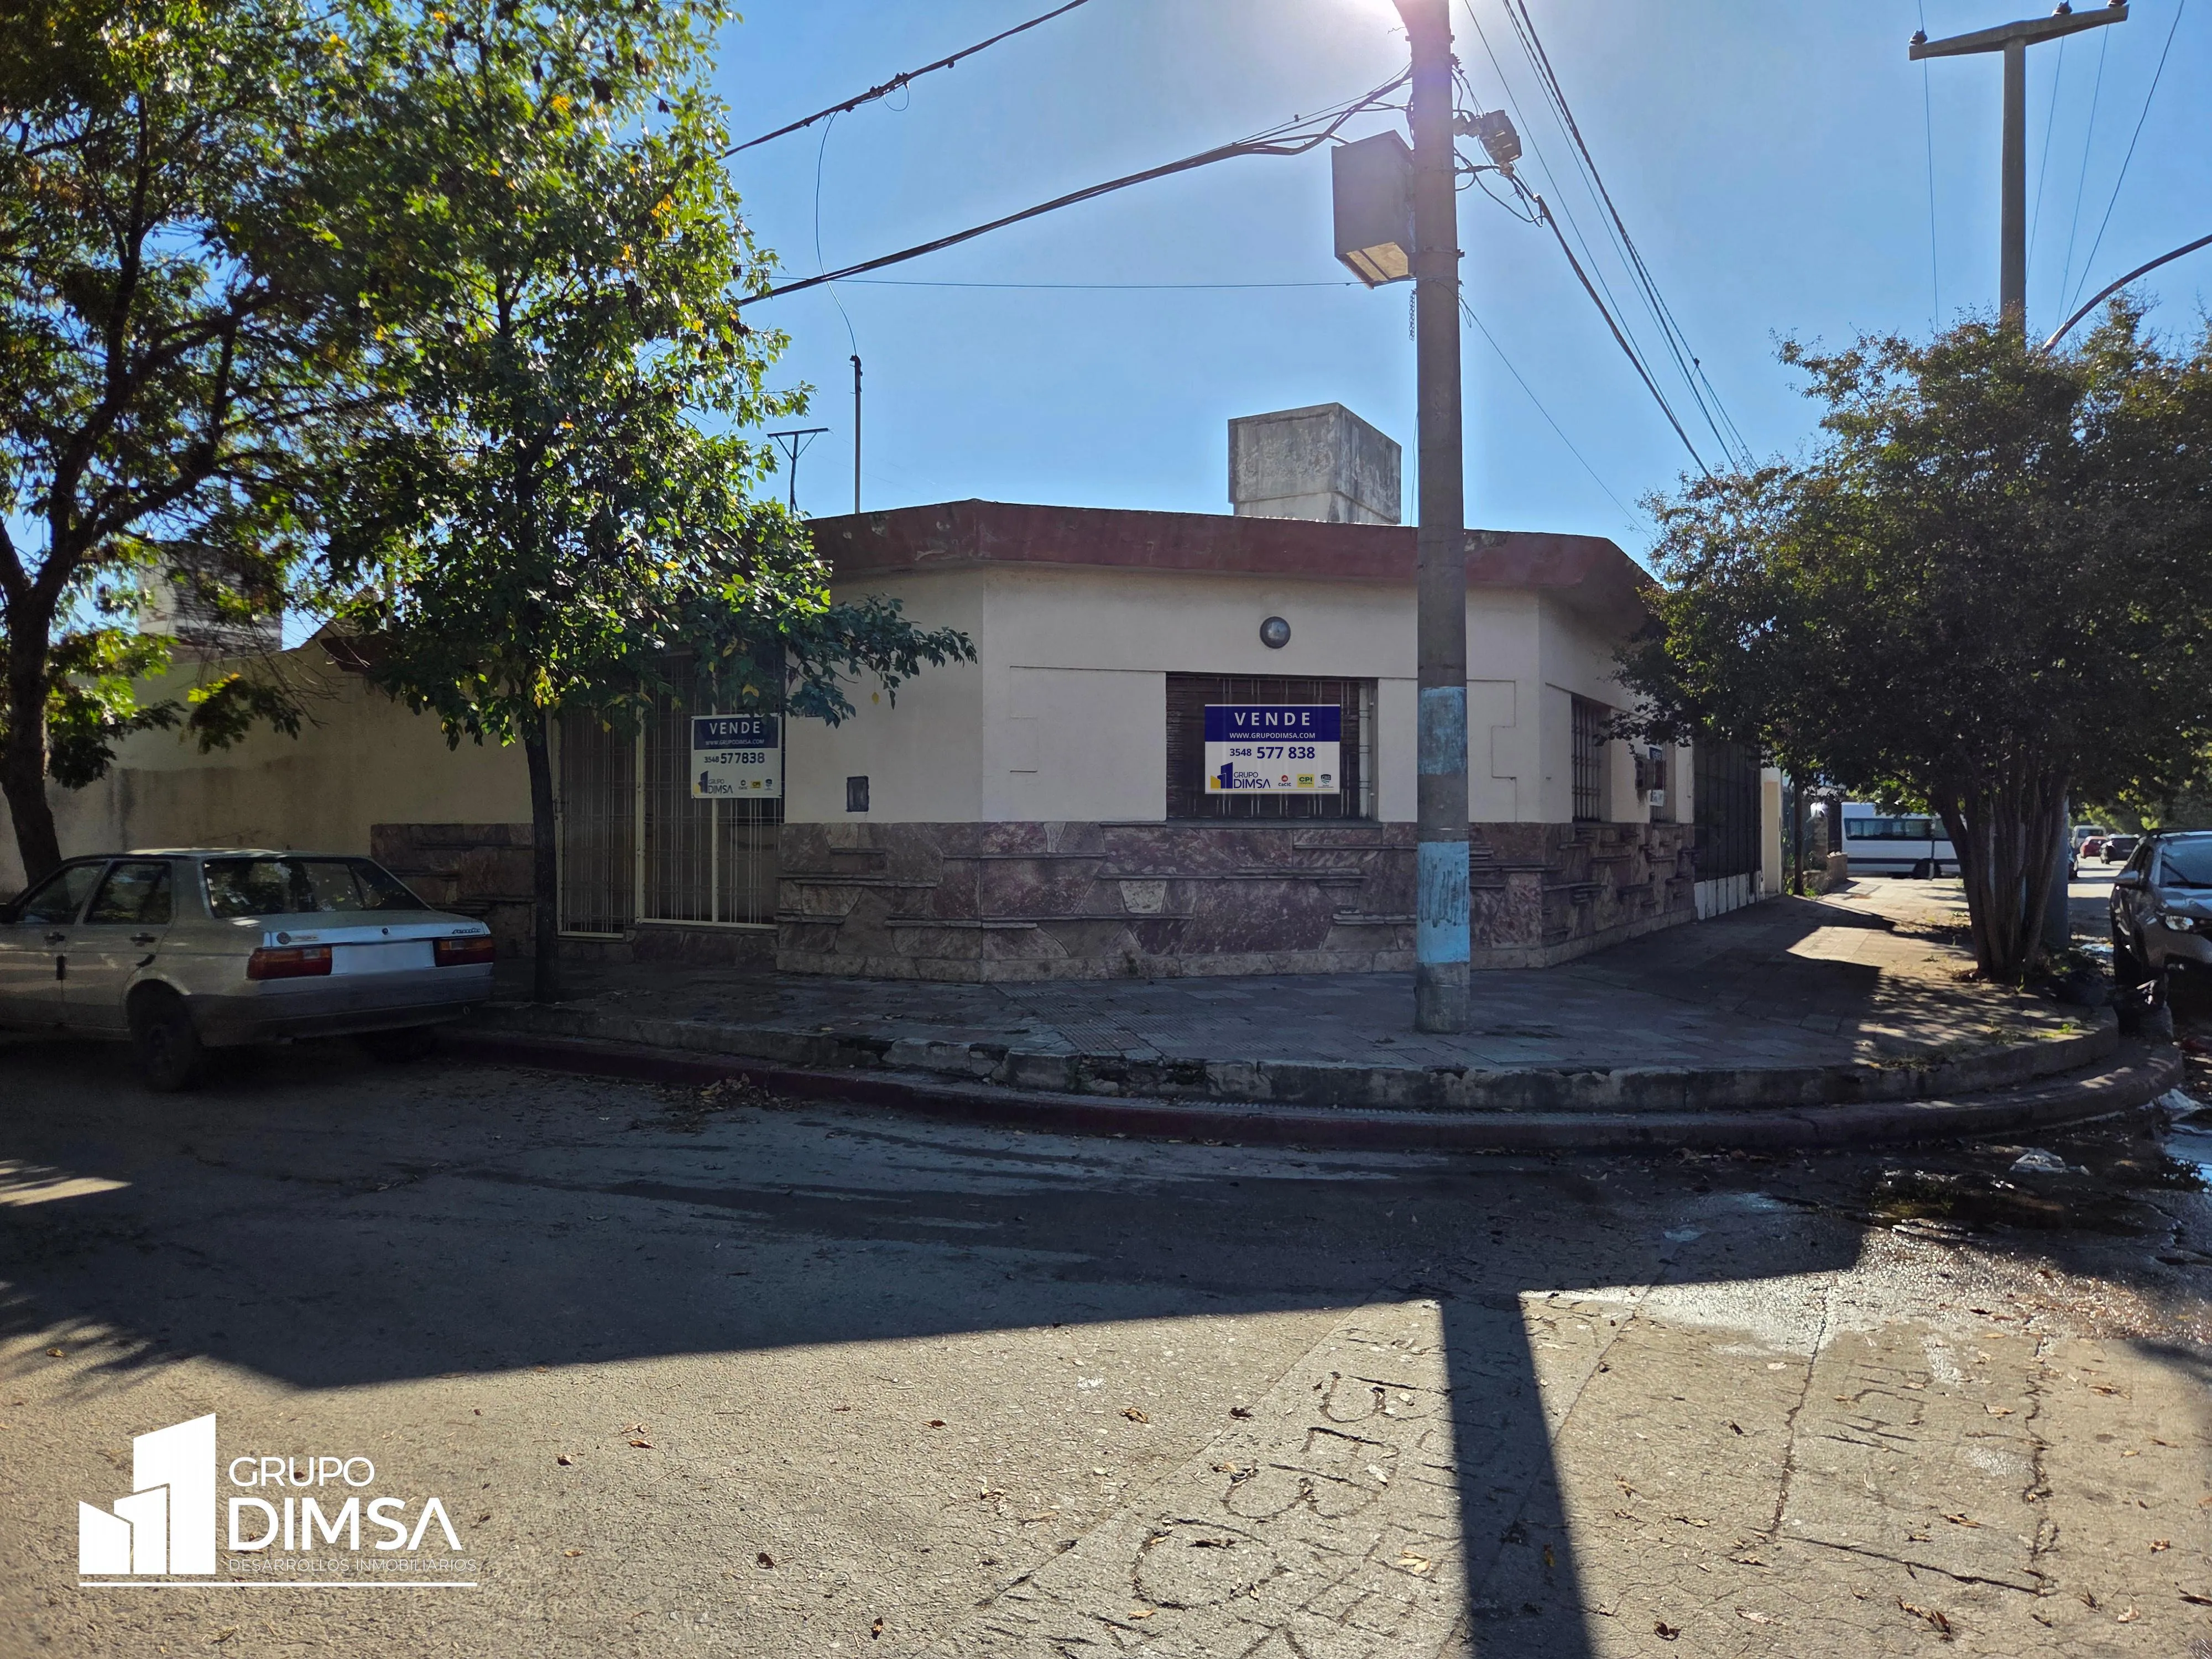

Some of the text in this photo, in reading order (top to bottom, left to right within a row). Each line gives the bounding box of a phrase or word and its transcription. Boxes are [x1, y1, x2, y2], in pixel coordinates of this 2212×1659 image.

[1234, 712, 1310, 726] VENDE
[709, 721, 761, 735] VENDE
[1229, 747, 1315, 759] 3548 577 838
[708, 785, 733, 794] DIMSA
[1233, 779, 1271, 789] DIMSA
